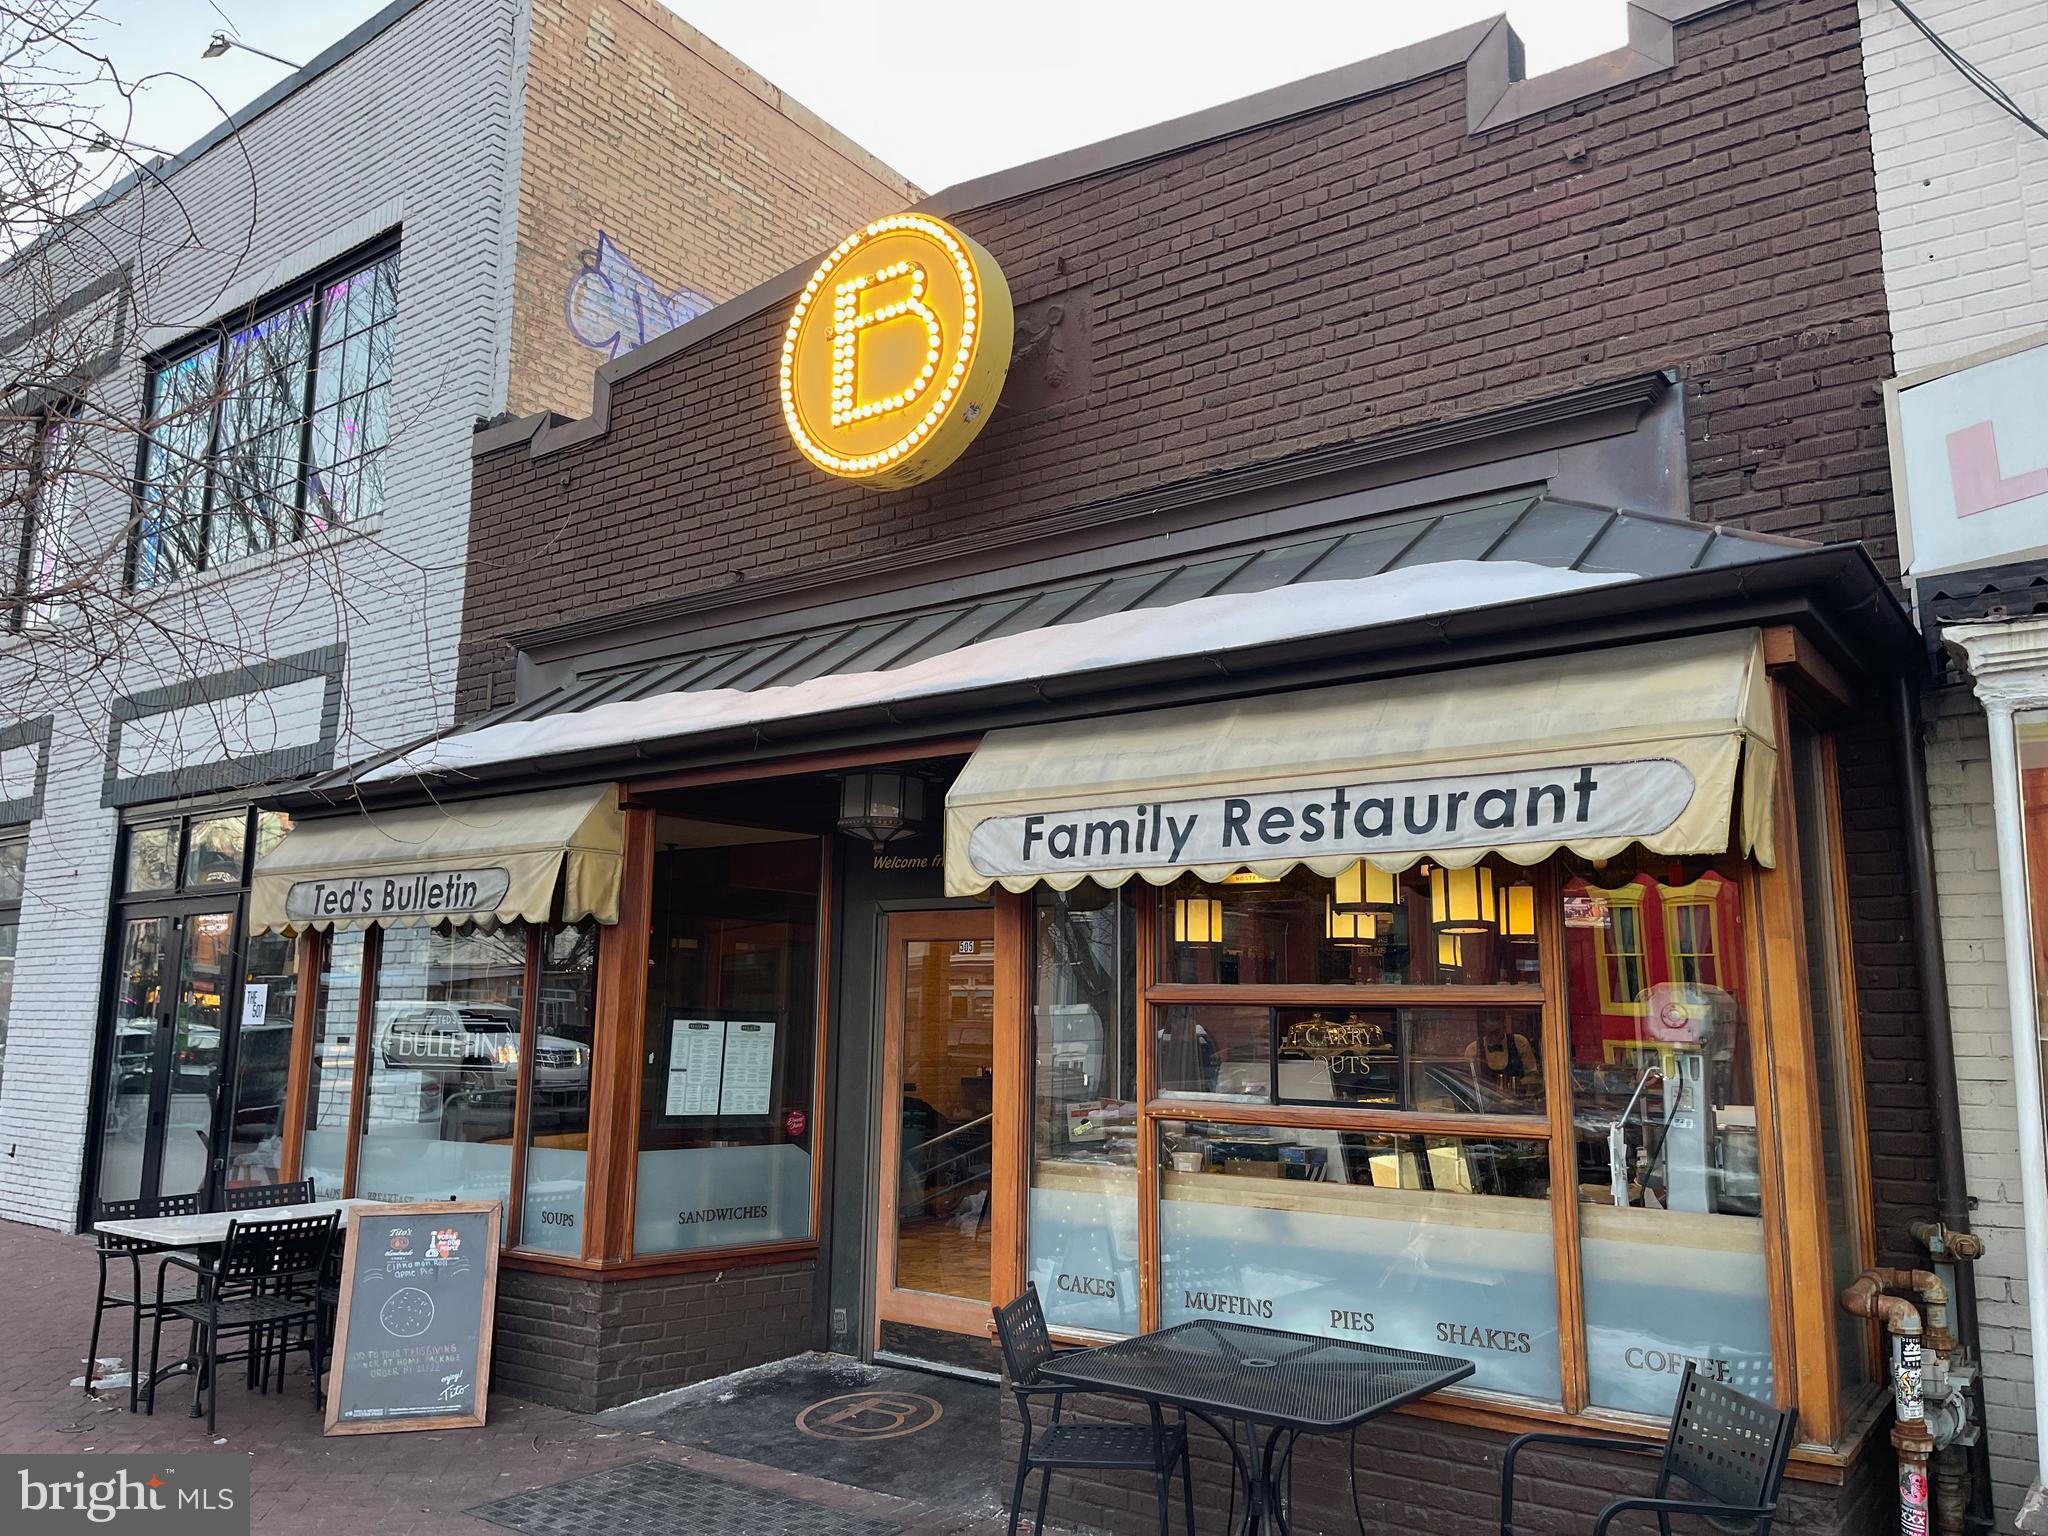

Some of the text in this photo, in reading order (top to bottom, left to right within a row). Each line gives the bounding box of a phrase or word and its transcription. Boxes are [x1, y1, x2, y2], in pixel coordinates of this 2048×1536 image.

[832, 261, 944, 430] B
[1023, 767, 1597, 863] Family Restaurant
[873, 855, 928, 869] Welcome
[313, 873, 478, 915] Ted's Bulletin
[959, 941, 974, 952] 505
[247, 990, 258, 1005] THE
[251, 1004, 264, 1018] 507
[399, 1031, 498, 1060] BULLETIN
[1305, 1026, 1375, 1046] CARRY
[541, 1210, 574, 1227] SOUPS
[678, 1205, 768, 1225] SANDWICHES
[1057, 1274, 1531, 1354] CAKES MUFFINS PIES SHAKES
[1624, 1347, 1733, 1383] COFEE
